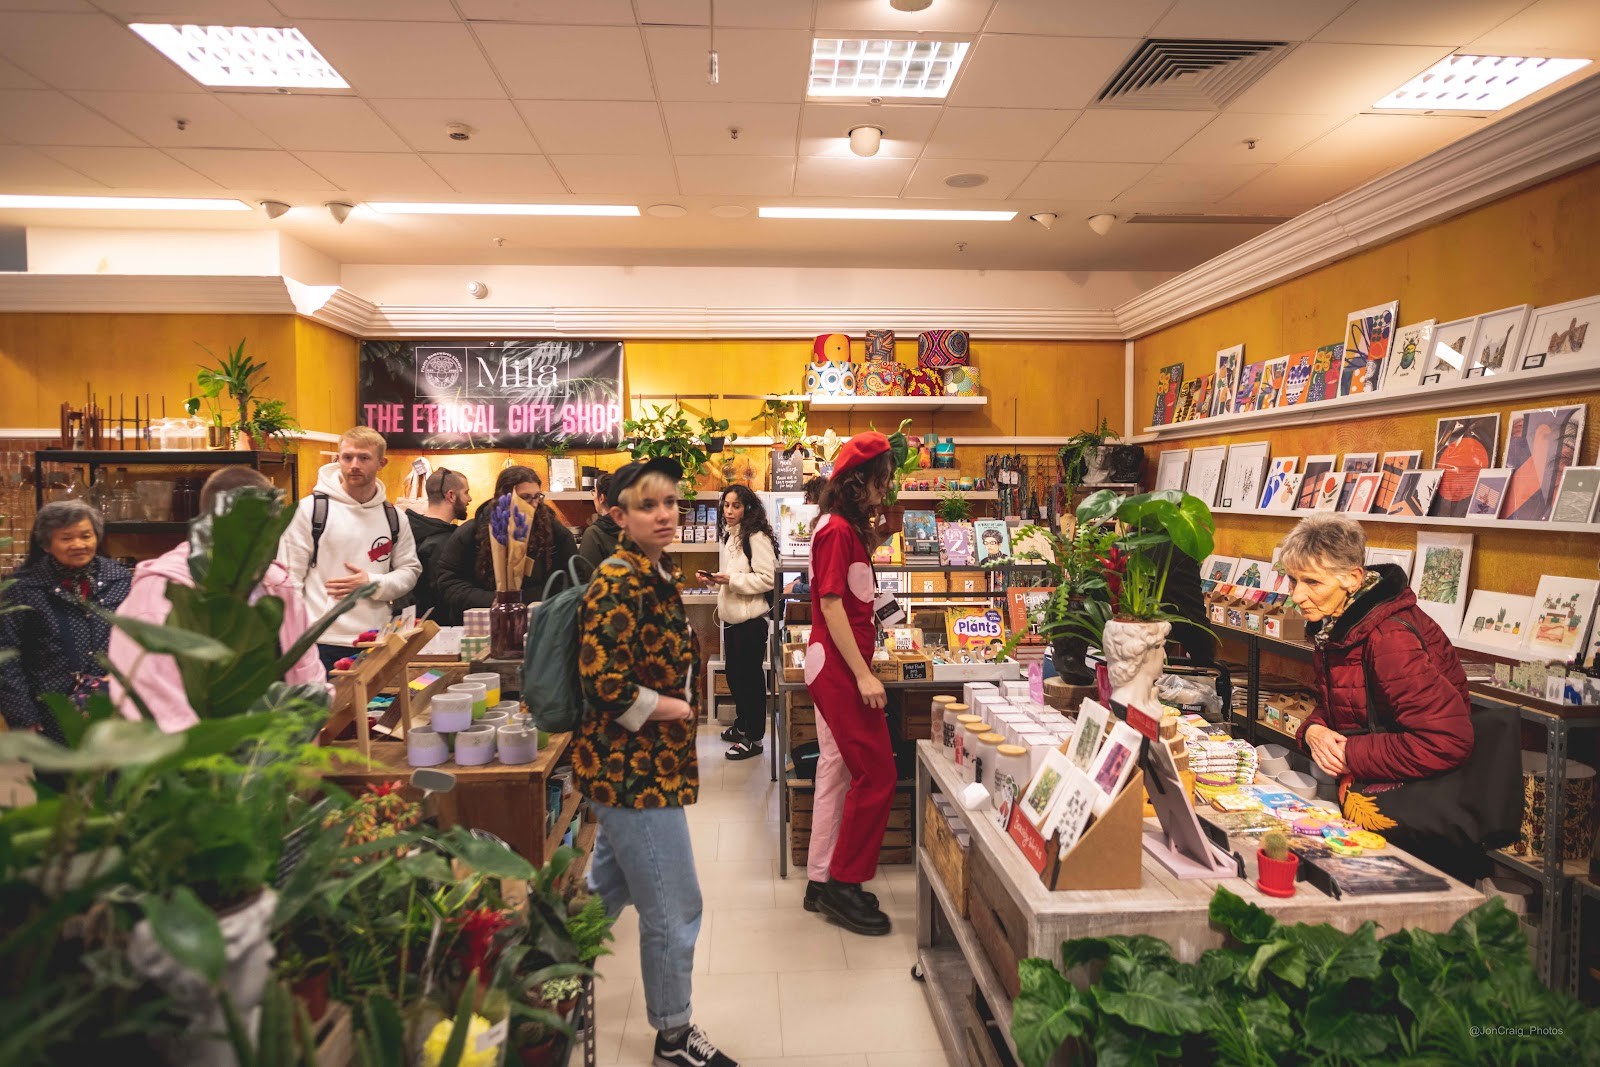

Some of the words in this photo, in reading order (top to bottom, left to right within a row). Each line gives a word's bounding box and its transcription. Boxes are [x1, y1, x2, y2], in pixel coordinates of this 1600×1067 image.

[476, 356, 558, 388] Mila
[363, 403, 404, 433] THE
[412, 404, 500, 433] ETHICAL
[508, 404, 555, 433] GIFT
[562, 403, 620, 433] SHOP
[948, 539, 966, 554] Z
[958, 620, 998, 634] Plants
